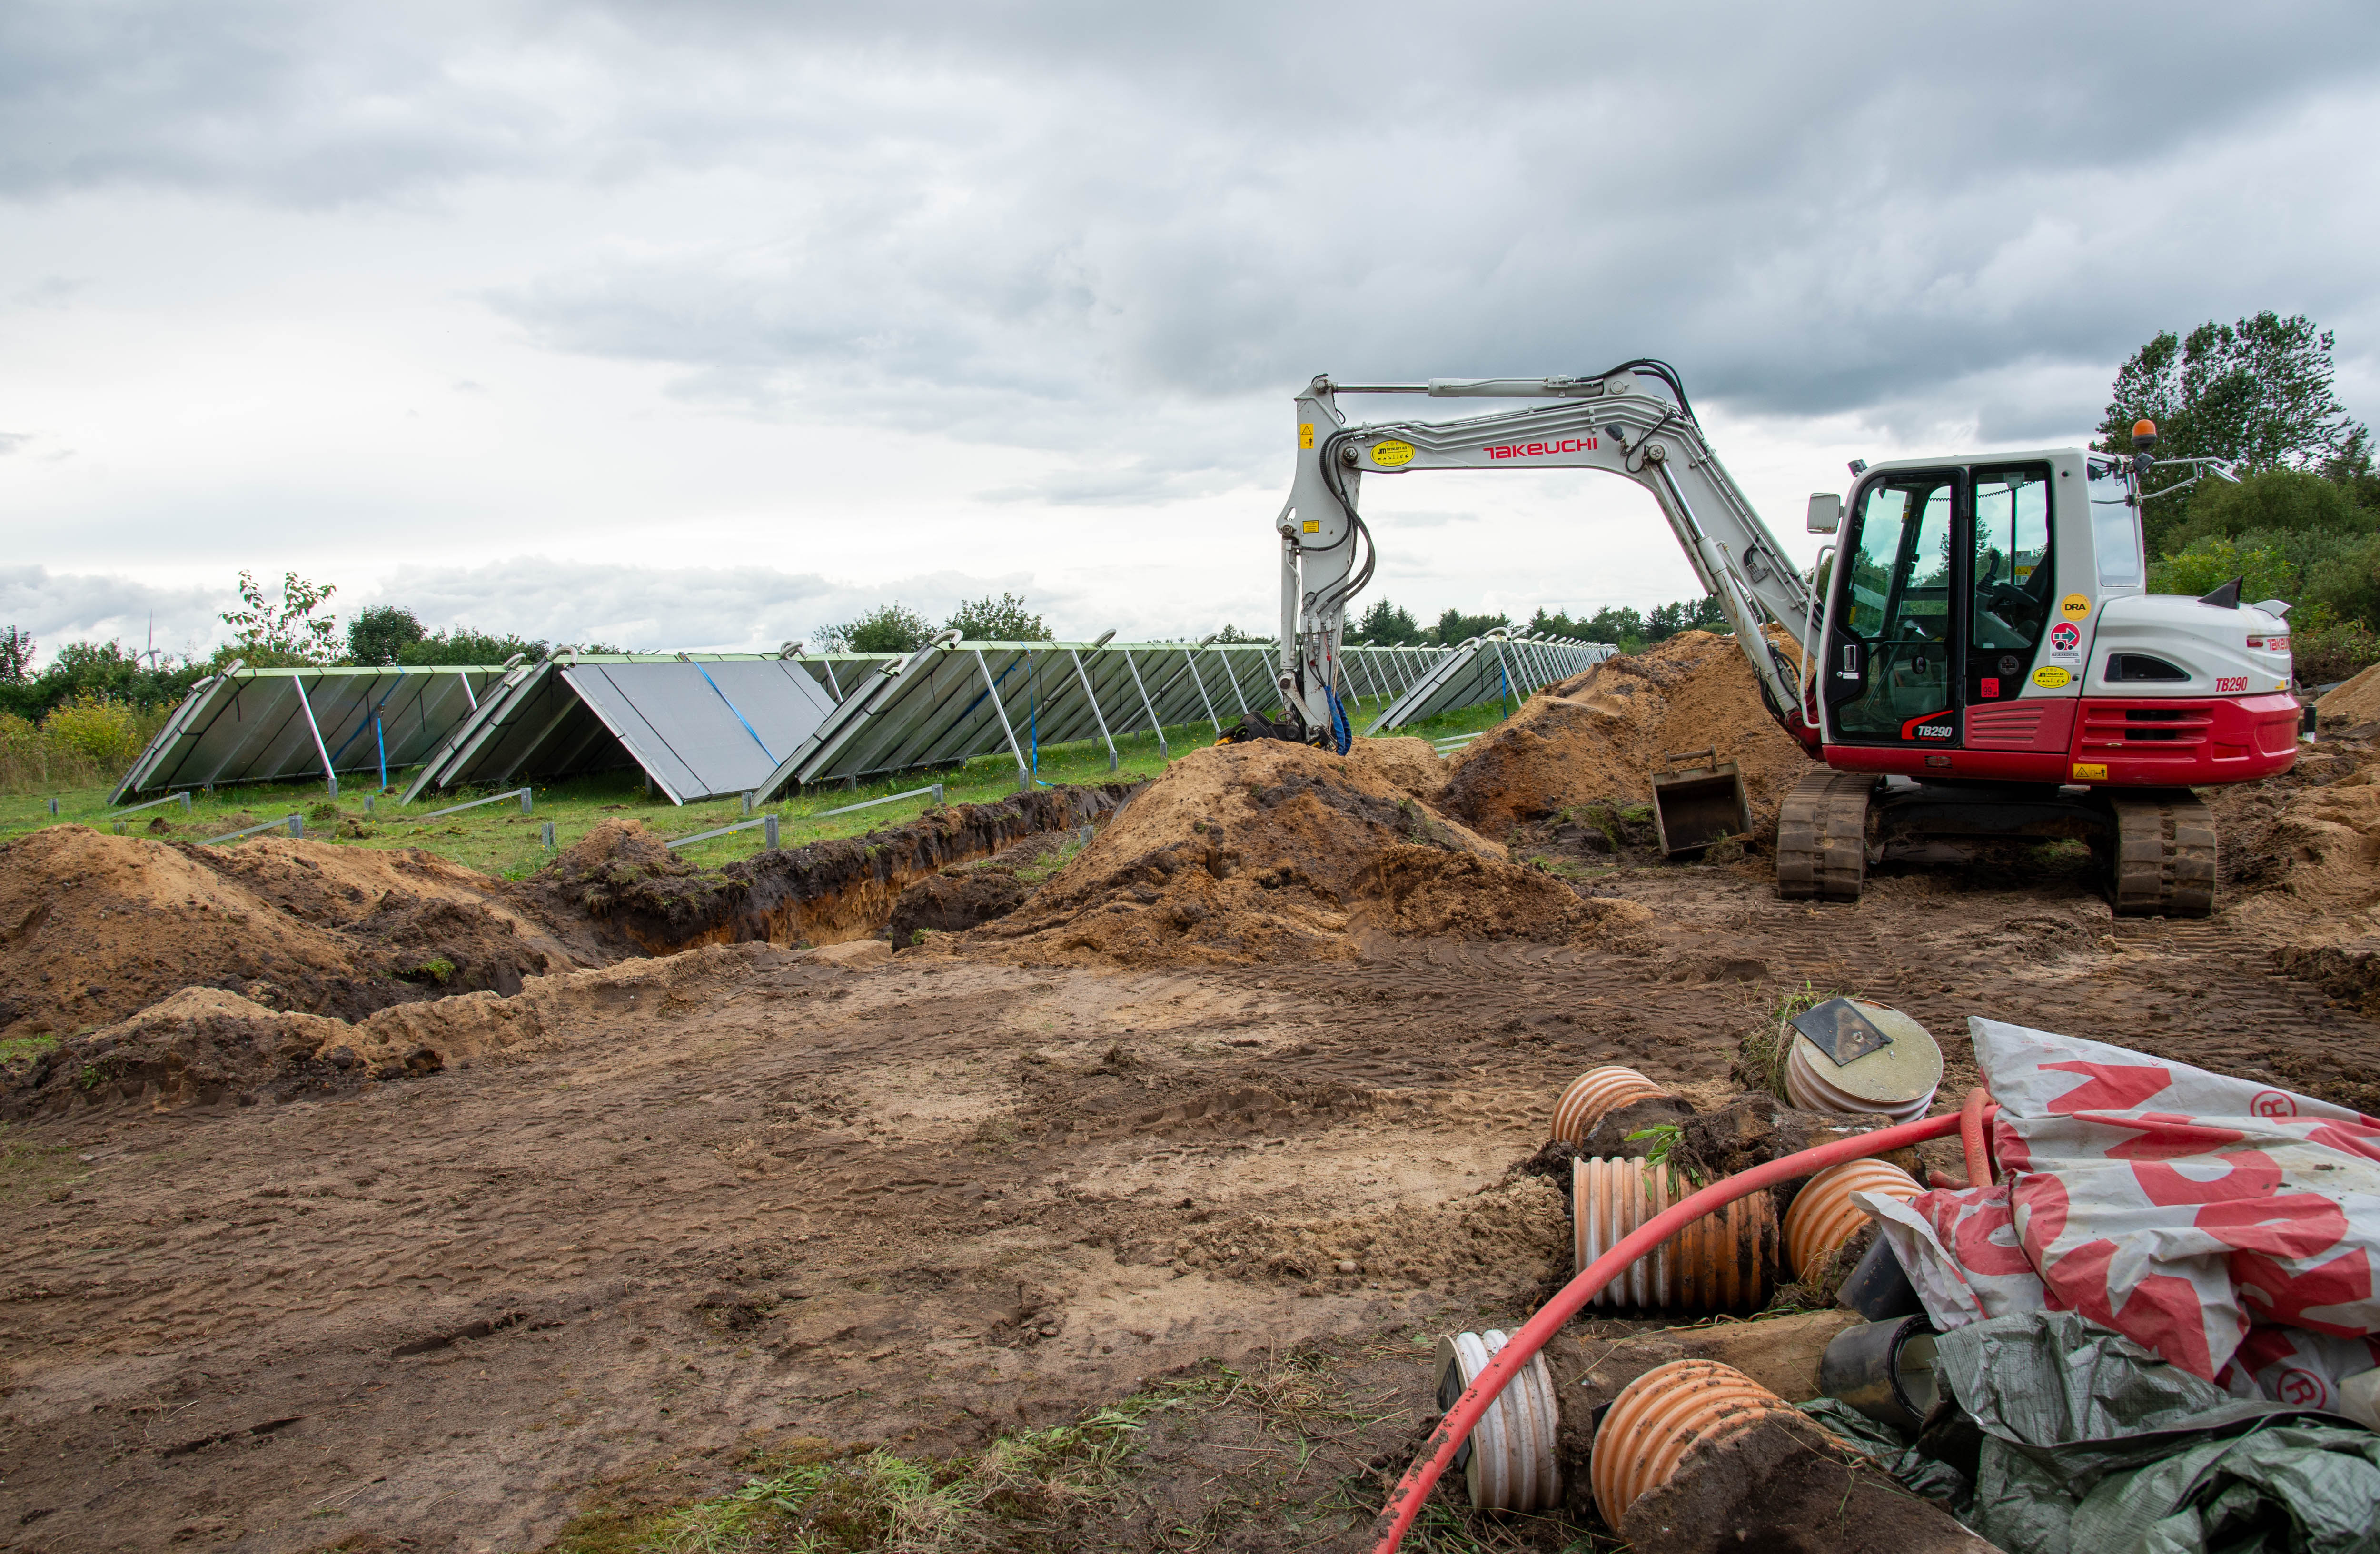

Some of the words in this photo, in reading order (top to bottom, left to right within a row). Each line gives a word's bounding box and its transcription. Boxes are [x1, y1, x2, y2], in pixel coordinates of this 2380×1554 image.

[1483, 437, 1597, 459] TAKEUCHI
[1983, 686, 1992, 695] 99
[2215, 676, 2248, 692] TB290
[1918, 726, 1953, 737] TB290
